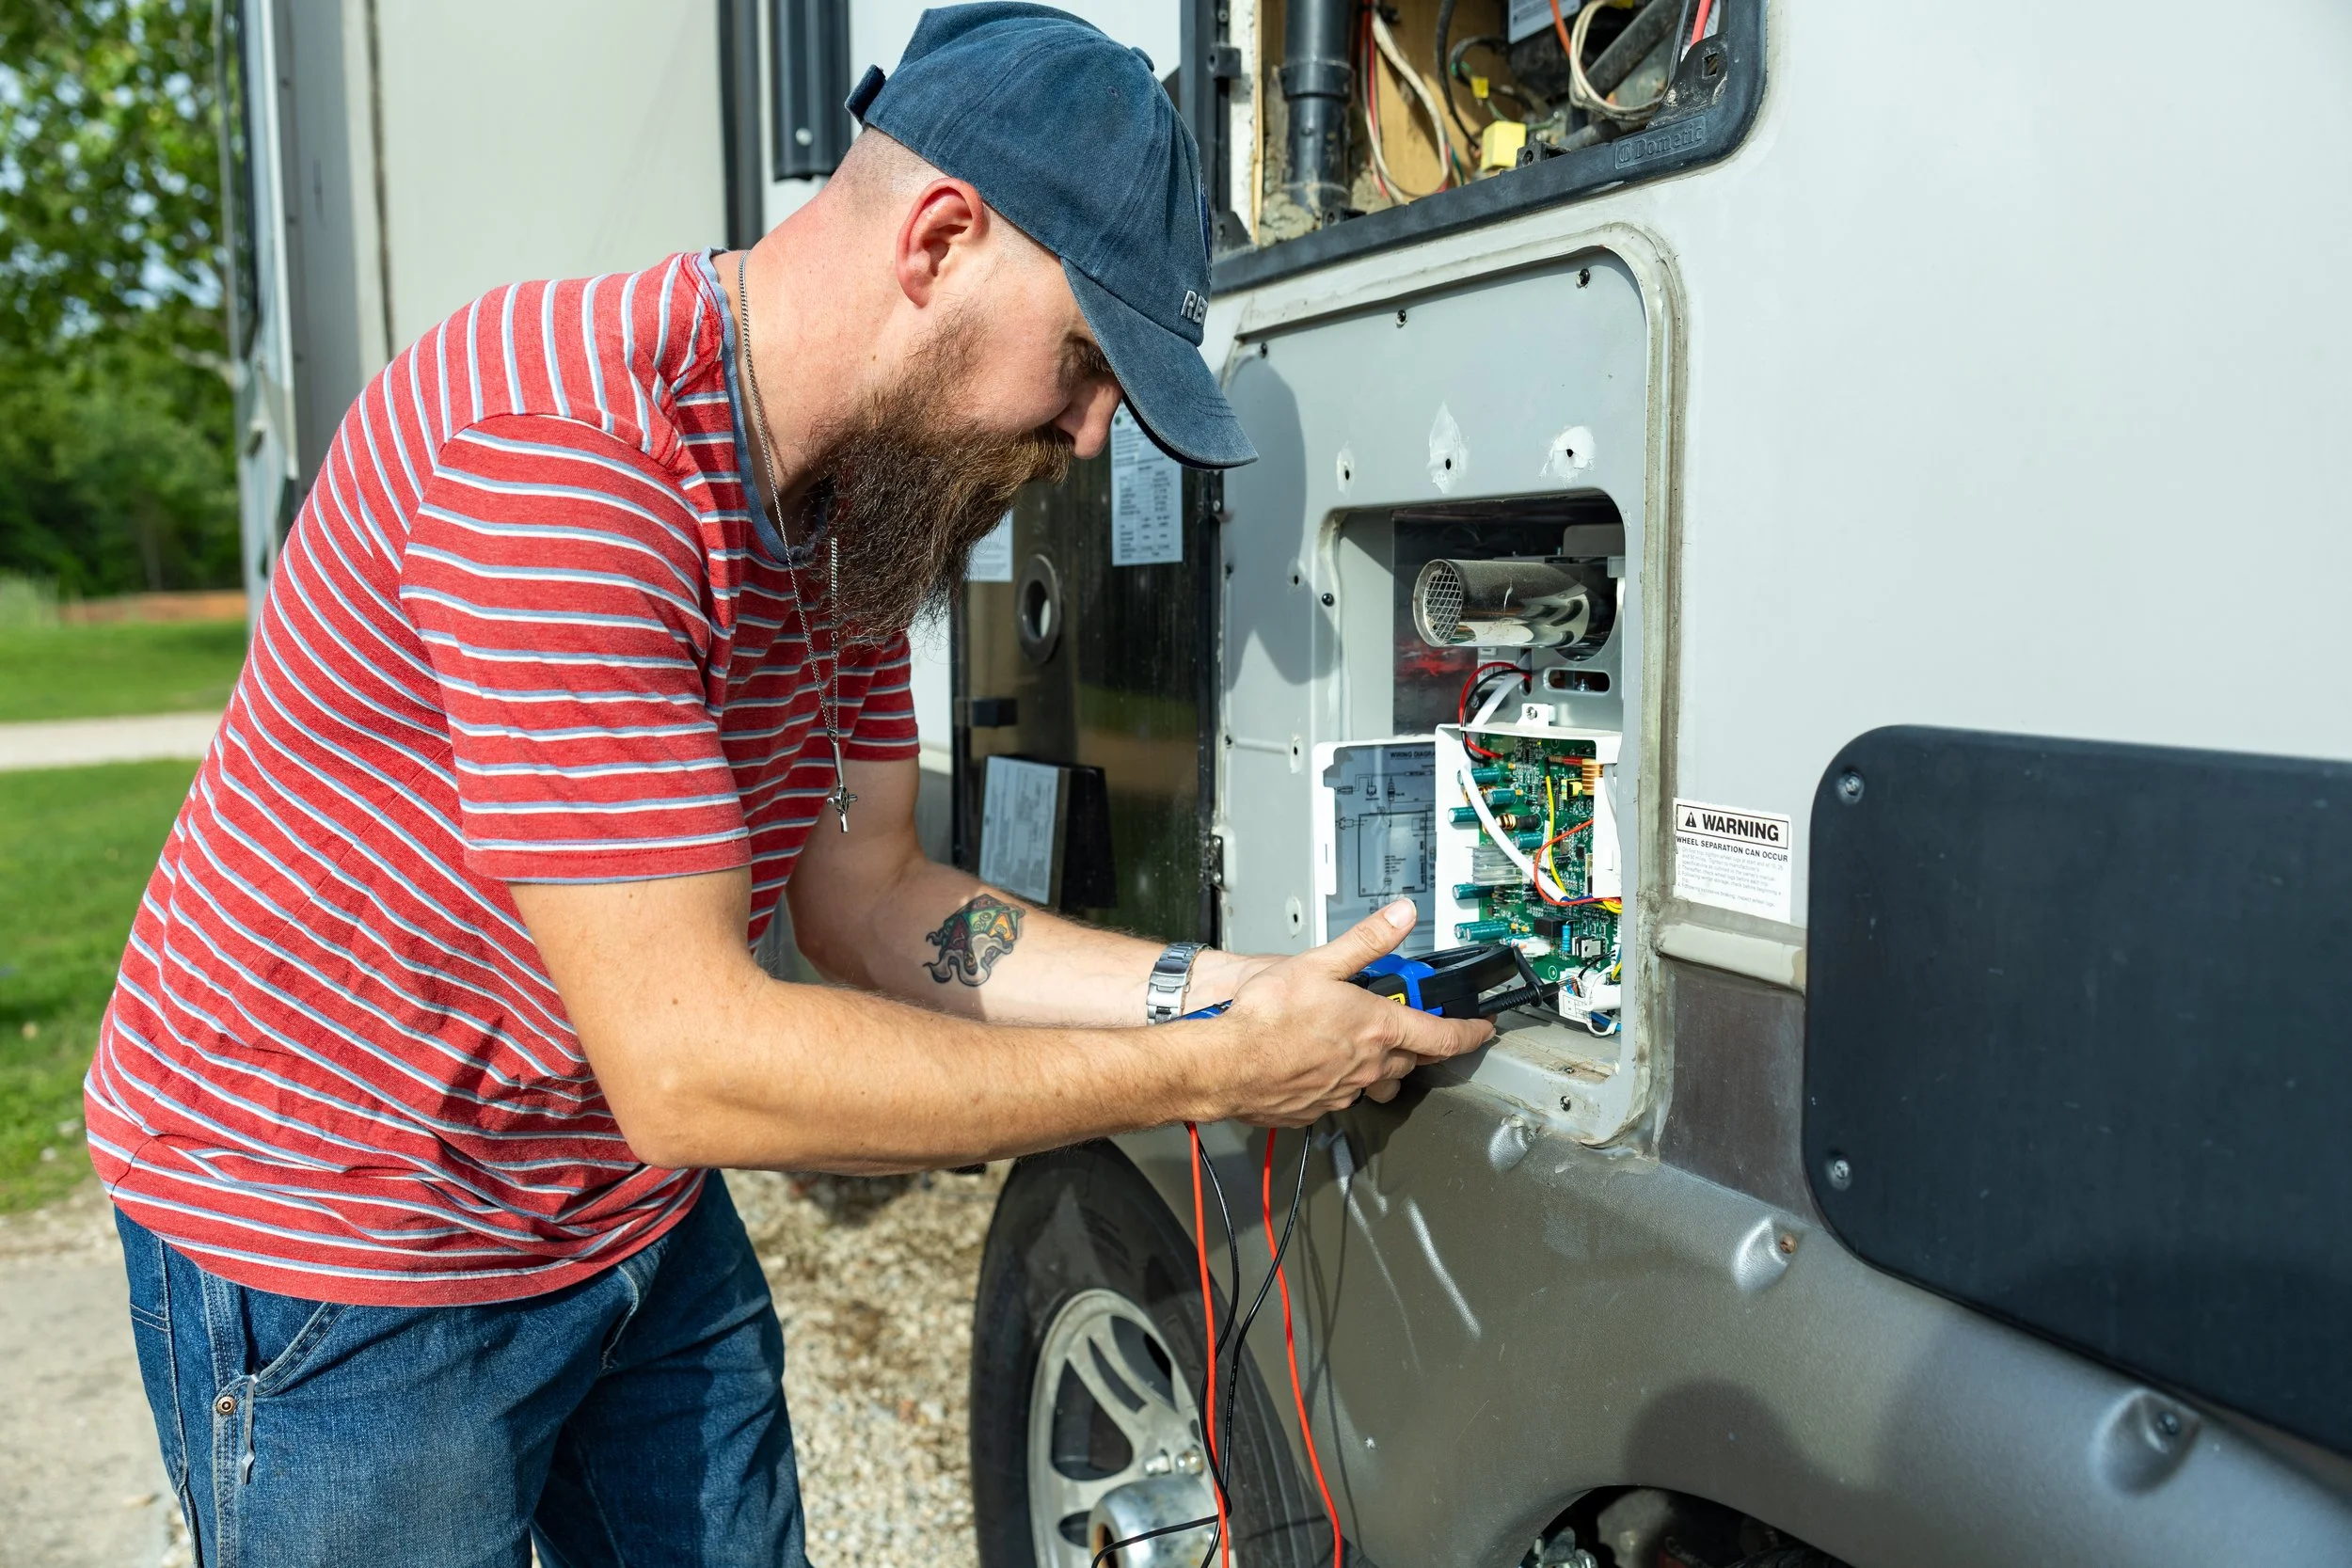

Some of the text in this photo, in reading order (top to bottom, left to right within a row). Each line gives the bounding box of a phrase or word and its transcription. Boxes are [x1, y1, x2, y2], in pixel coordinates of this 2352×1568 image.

[1631, 123, 1703, 159] Dometic
[1180, 290, 1208, 325] RE
[1702, 813, 1779, 842] WARNING
[1676, 835, 1788, 863] WHEEL SEPARATION CAN OCCUR
